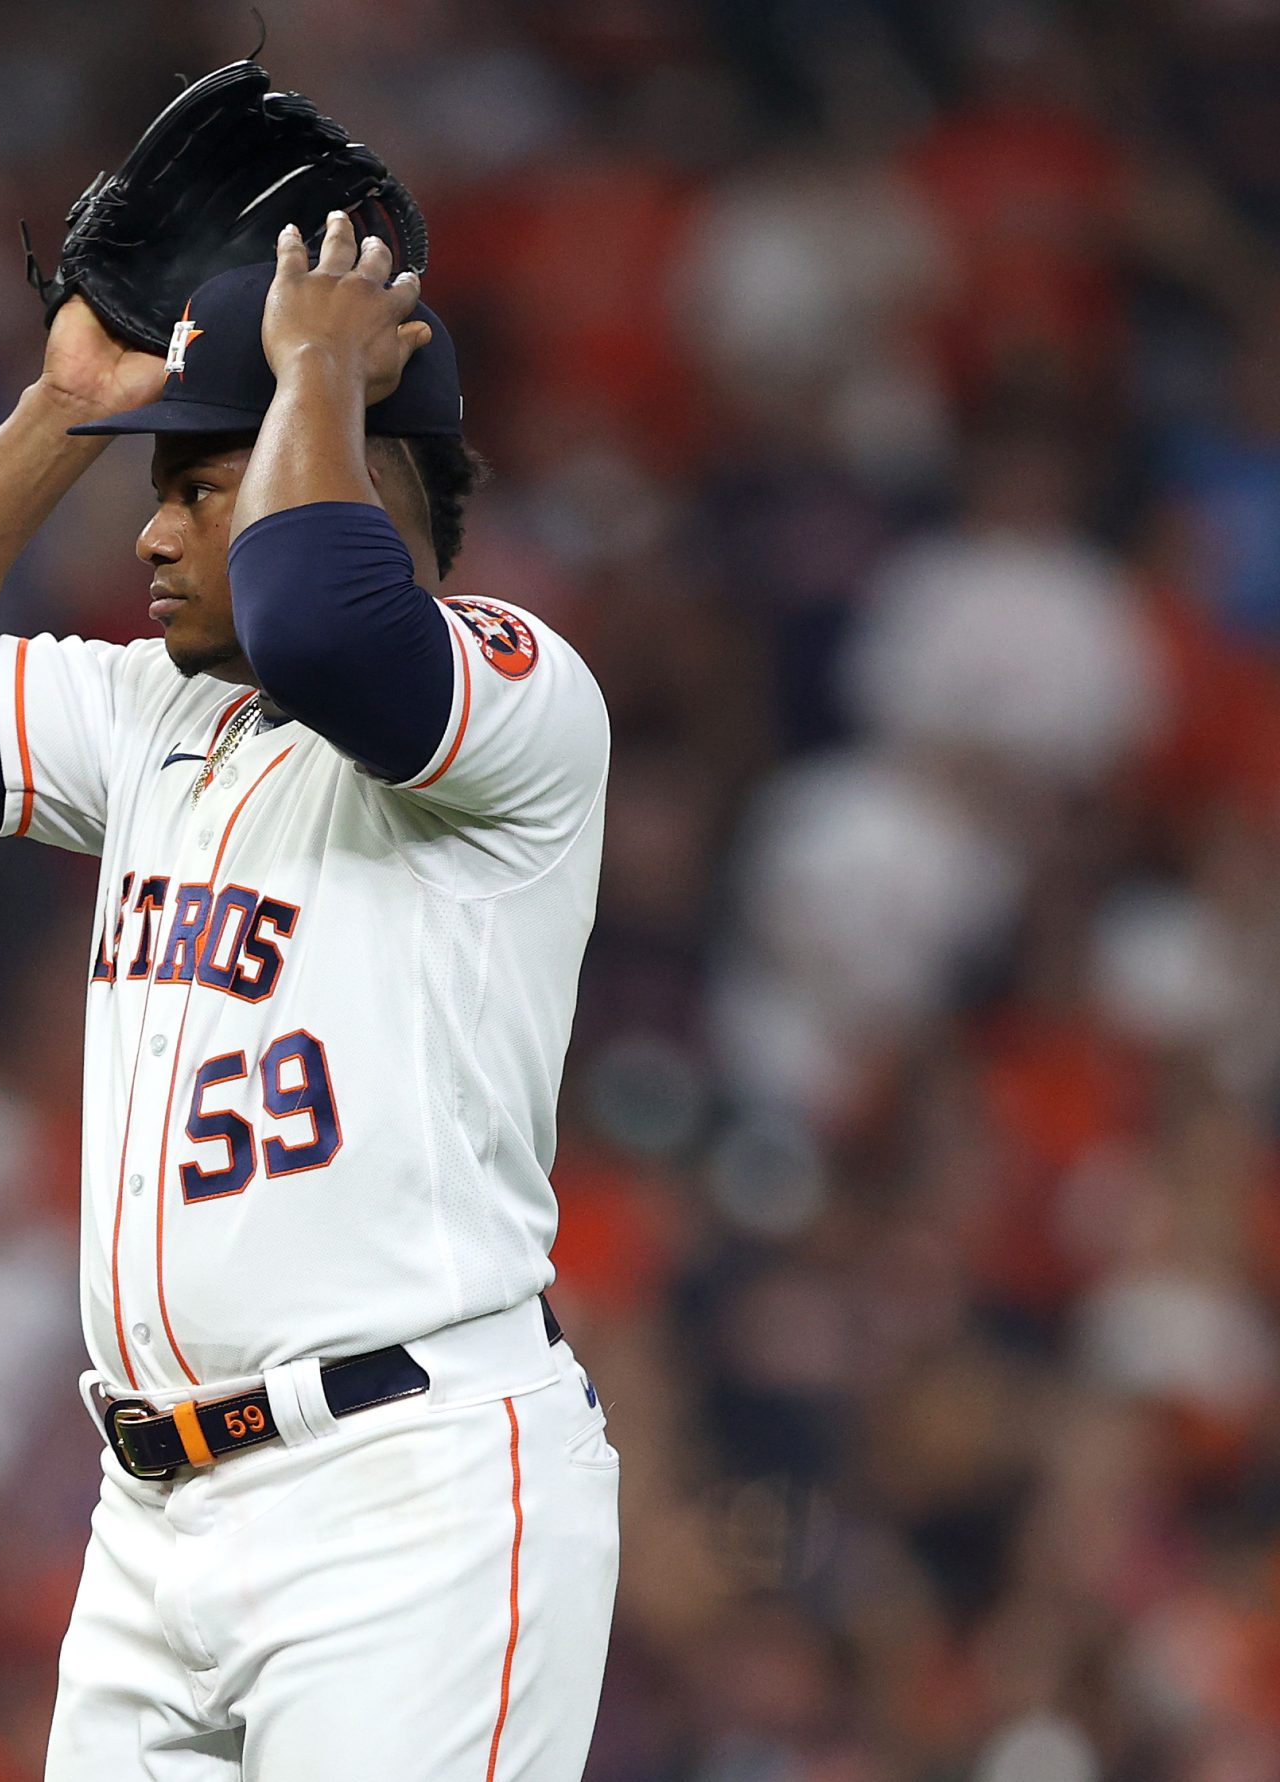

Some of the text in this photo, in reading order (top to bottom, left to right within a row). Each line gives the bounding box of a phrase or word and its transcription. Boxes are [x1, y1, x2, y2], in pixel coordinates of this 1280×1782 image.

[91, 871, 300, 1004] TROS
[179, 1028, 343, 1205] 59
[223, 1405, 265, 1438] 59
